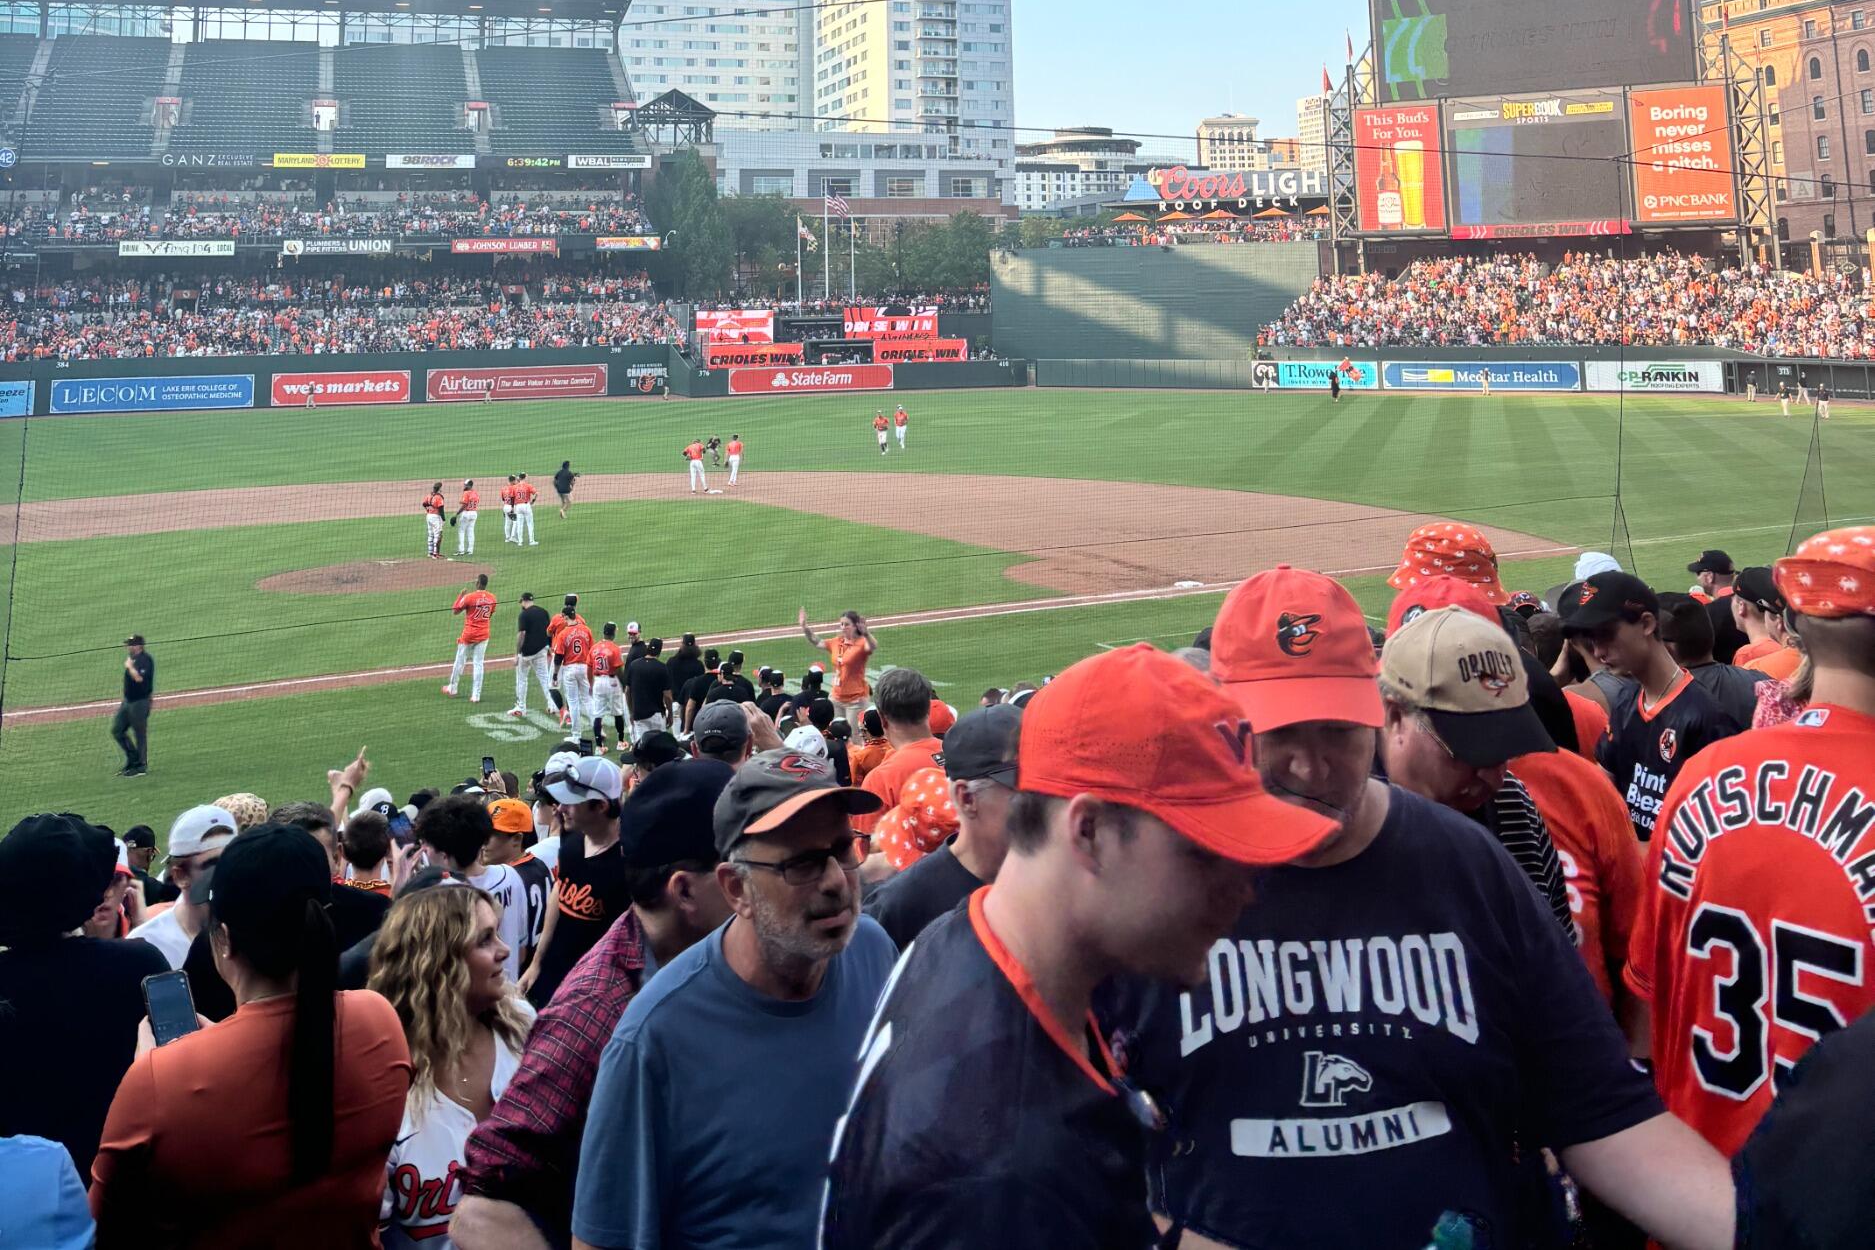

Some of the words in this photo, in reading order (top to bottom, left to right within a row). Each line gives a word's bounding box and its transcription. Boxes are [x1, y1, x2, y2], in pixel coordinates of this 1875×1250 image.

[1502, 99, 1563, 119] SUPERBOOK
[1650, 105, 1708, 121] Boring
[1363, 114, 1393, 126] This
[1396, 111, 1430, 124] Bud's
[1516, 116, 1549, 124] SPORTS
[1372, 129, 1392, 140] For
[1395, 127, 1423, 138] You.
[1655, 123, 1705, 138] never
[1652, 139, 1712, 155] misses
[0, 152, 12, 163] 42
[162, 154, 215, 166] GANZ
[277, 156, 316, 165] MARYLAND
[331, 157, 361, 165] LOTTERY
[507, 158, 548, 167] 6:39:42
[577, 157, 610, 166] WBAL
[1652, 160, 1664, 172] a
[1668, 155, 1719, 174] pitch.
[1158, 165, 1247, 199] Coors
[1252, 170, 1328, 195] LIGH
[1159, 199, 1218, 211] ROOF
[1238, 195, 1298, 208] DECK
[1494, 224, 1556, 237] ORIOLES
[1558, 225, 1587, 235] WIN
[349, 240, 391, 251] UNION
[472, 241, 506, 250] JOHNSON
[509, 241, 537, 250] LUMBER
[935, 349, 960, 358] WIN
[626, 367, 668, 377] CHAMPIONS
[1512, 370, 1559, 382] Health
[283, 382, 323, 394] wes
[326, 379, 400, 393] markets
[439, 375, 495, 391] Airtemp
[161, 392, 208, 400] OSTEOPATHIC
[209, 391, 242, 399] MEDICINE
[474, 606, 491, 620] 72
[573, 640, 581, 654] 6
[595, 656, 609, 670] 31
[1658, 759, 1875, 945] RUTSCHMA
[1179, 931, 1479, 1058] LONGWOOD
[1687, 901, 1864, 1101] 35
[1249, 1022, 1413, 1048] UNIVERSITY
[1268, 1110, 1421, 1153] ALUMNI
